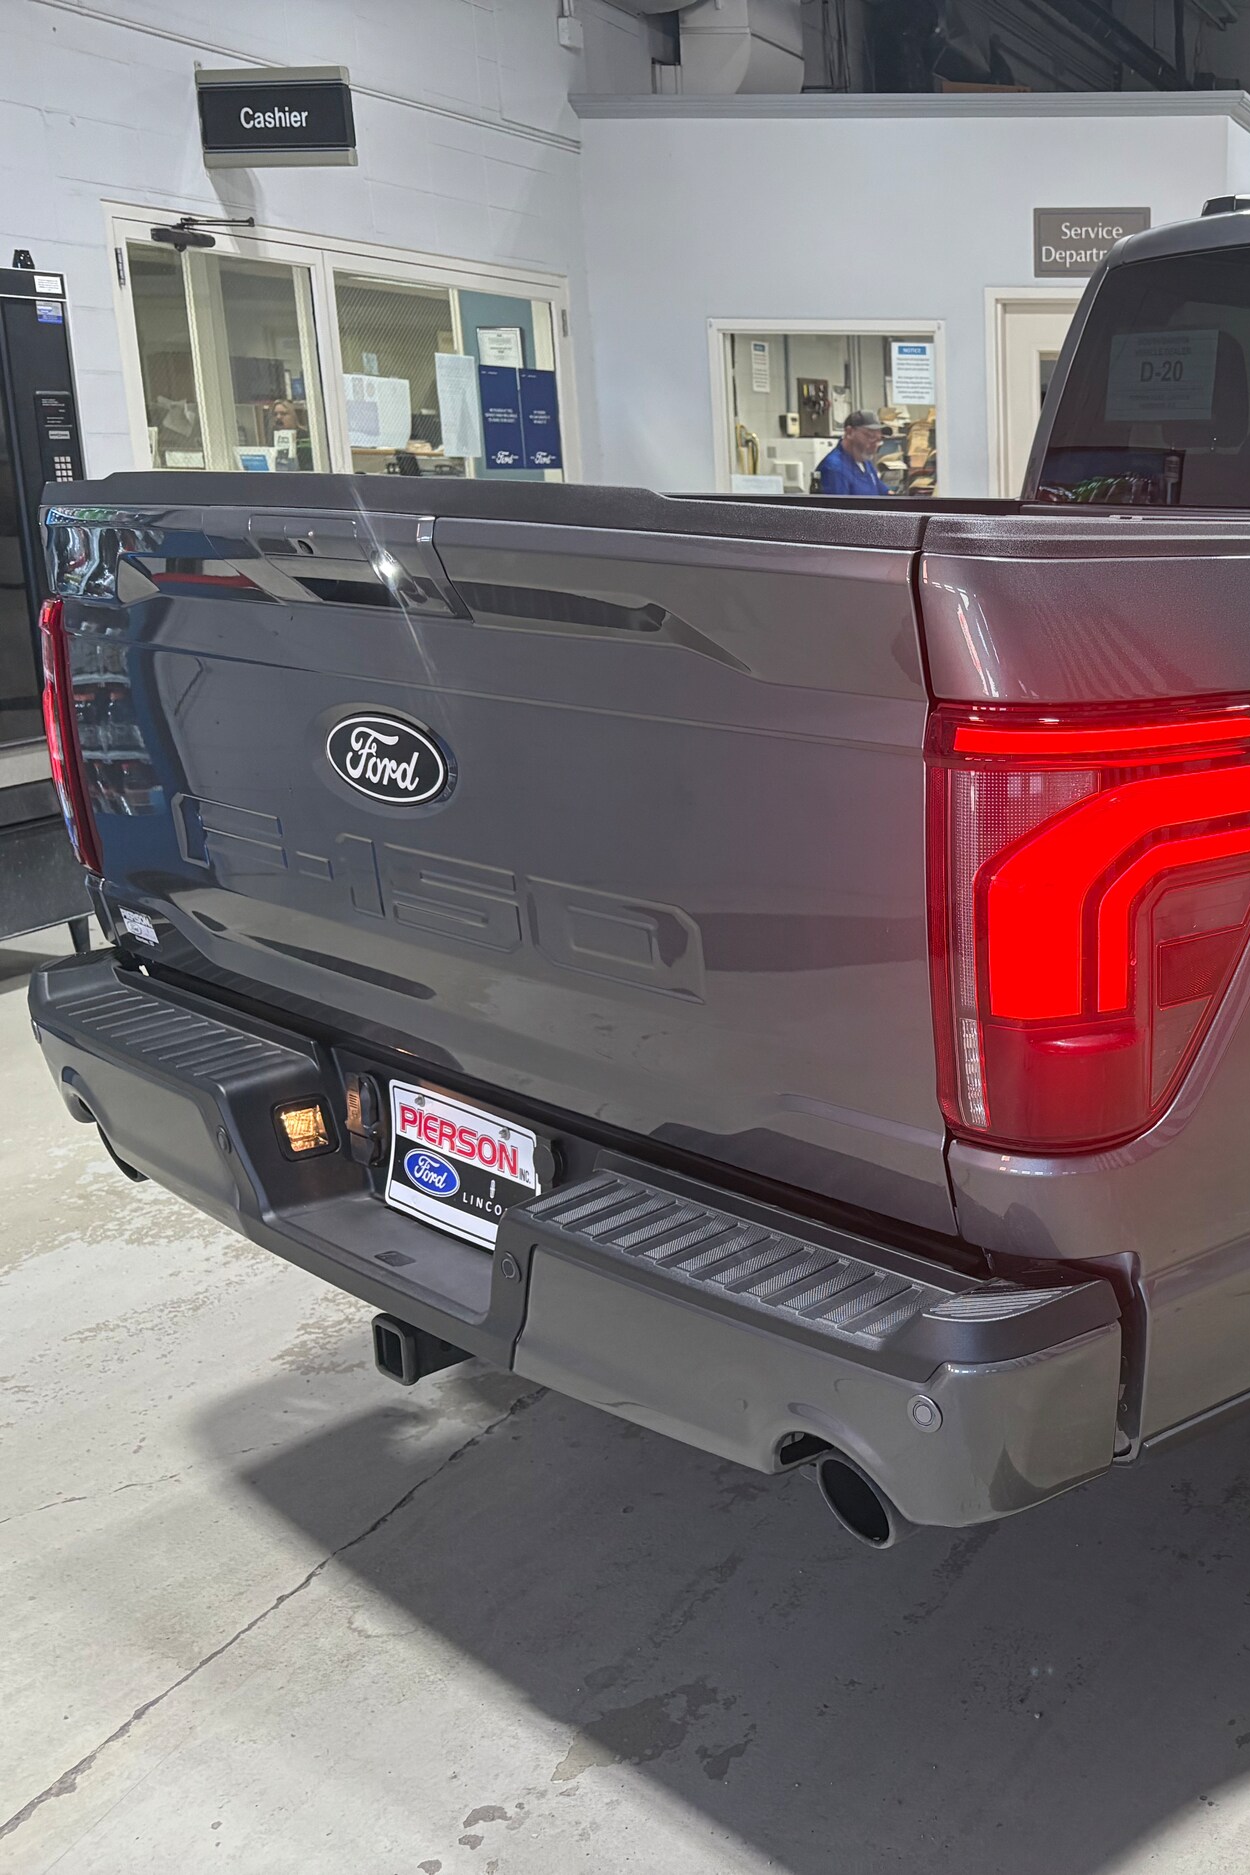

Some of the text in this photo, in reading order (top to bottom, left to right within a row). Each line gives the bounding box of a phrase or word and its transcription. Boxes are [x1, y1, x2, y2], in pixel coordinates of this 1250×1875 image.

[240, 106, 309, 129] Cashier
[1061, 222, 1123, 240] Service
[1041, 246, 1107, 268] Depart
[1140, 360, 1184, 383] D-20
[345, 726, 420, 791] Ford
[171, 793, 707, 1006] F-150
[399, 1103, 531, 1184] PIERSON INC.
[413, 1155, 448, 1189] Ford
[462, 1191, 508, 1216] LINCO
